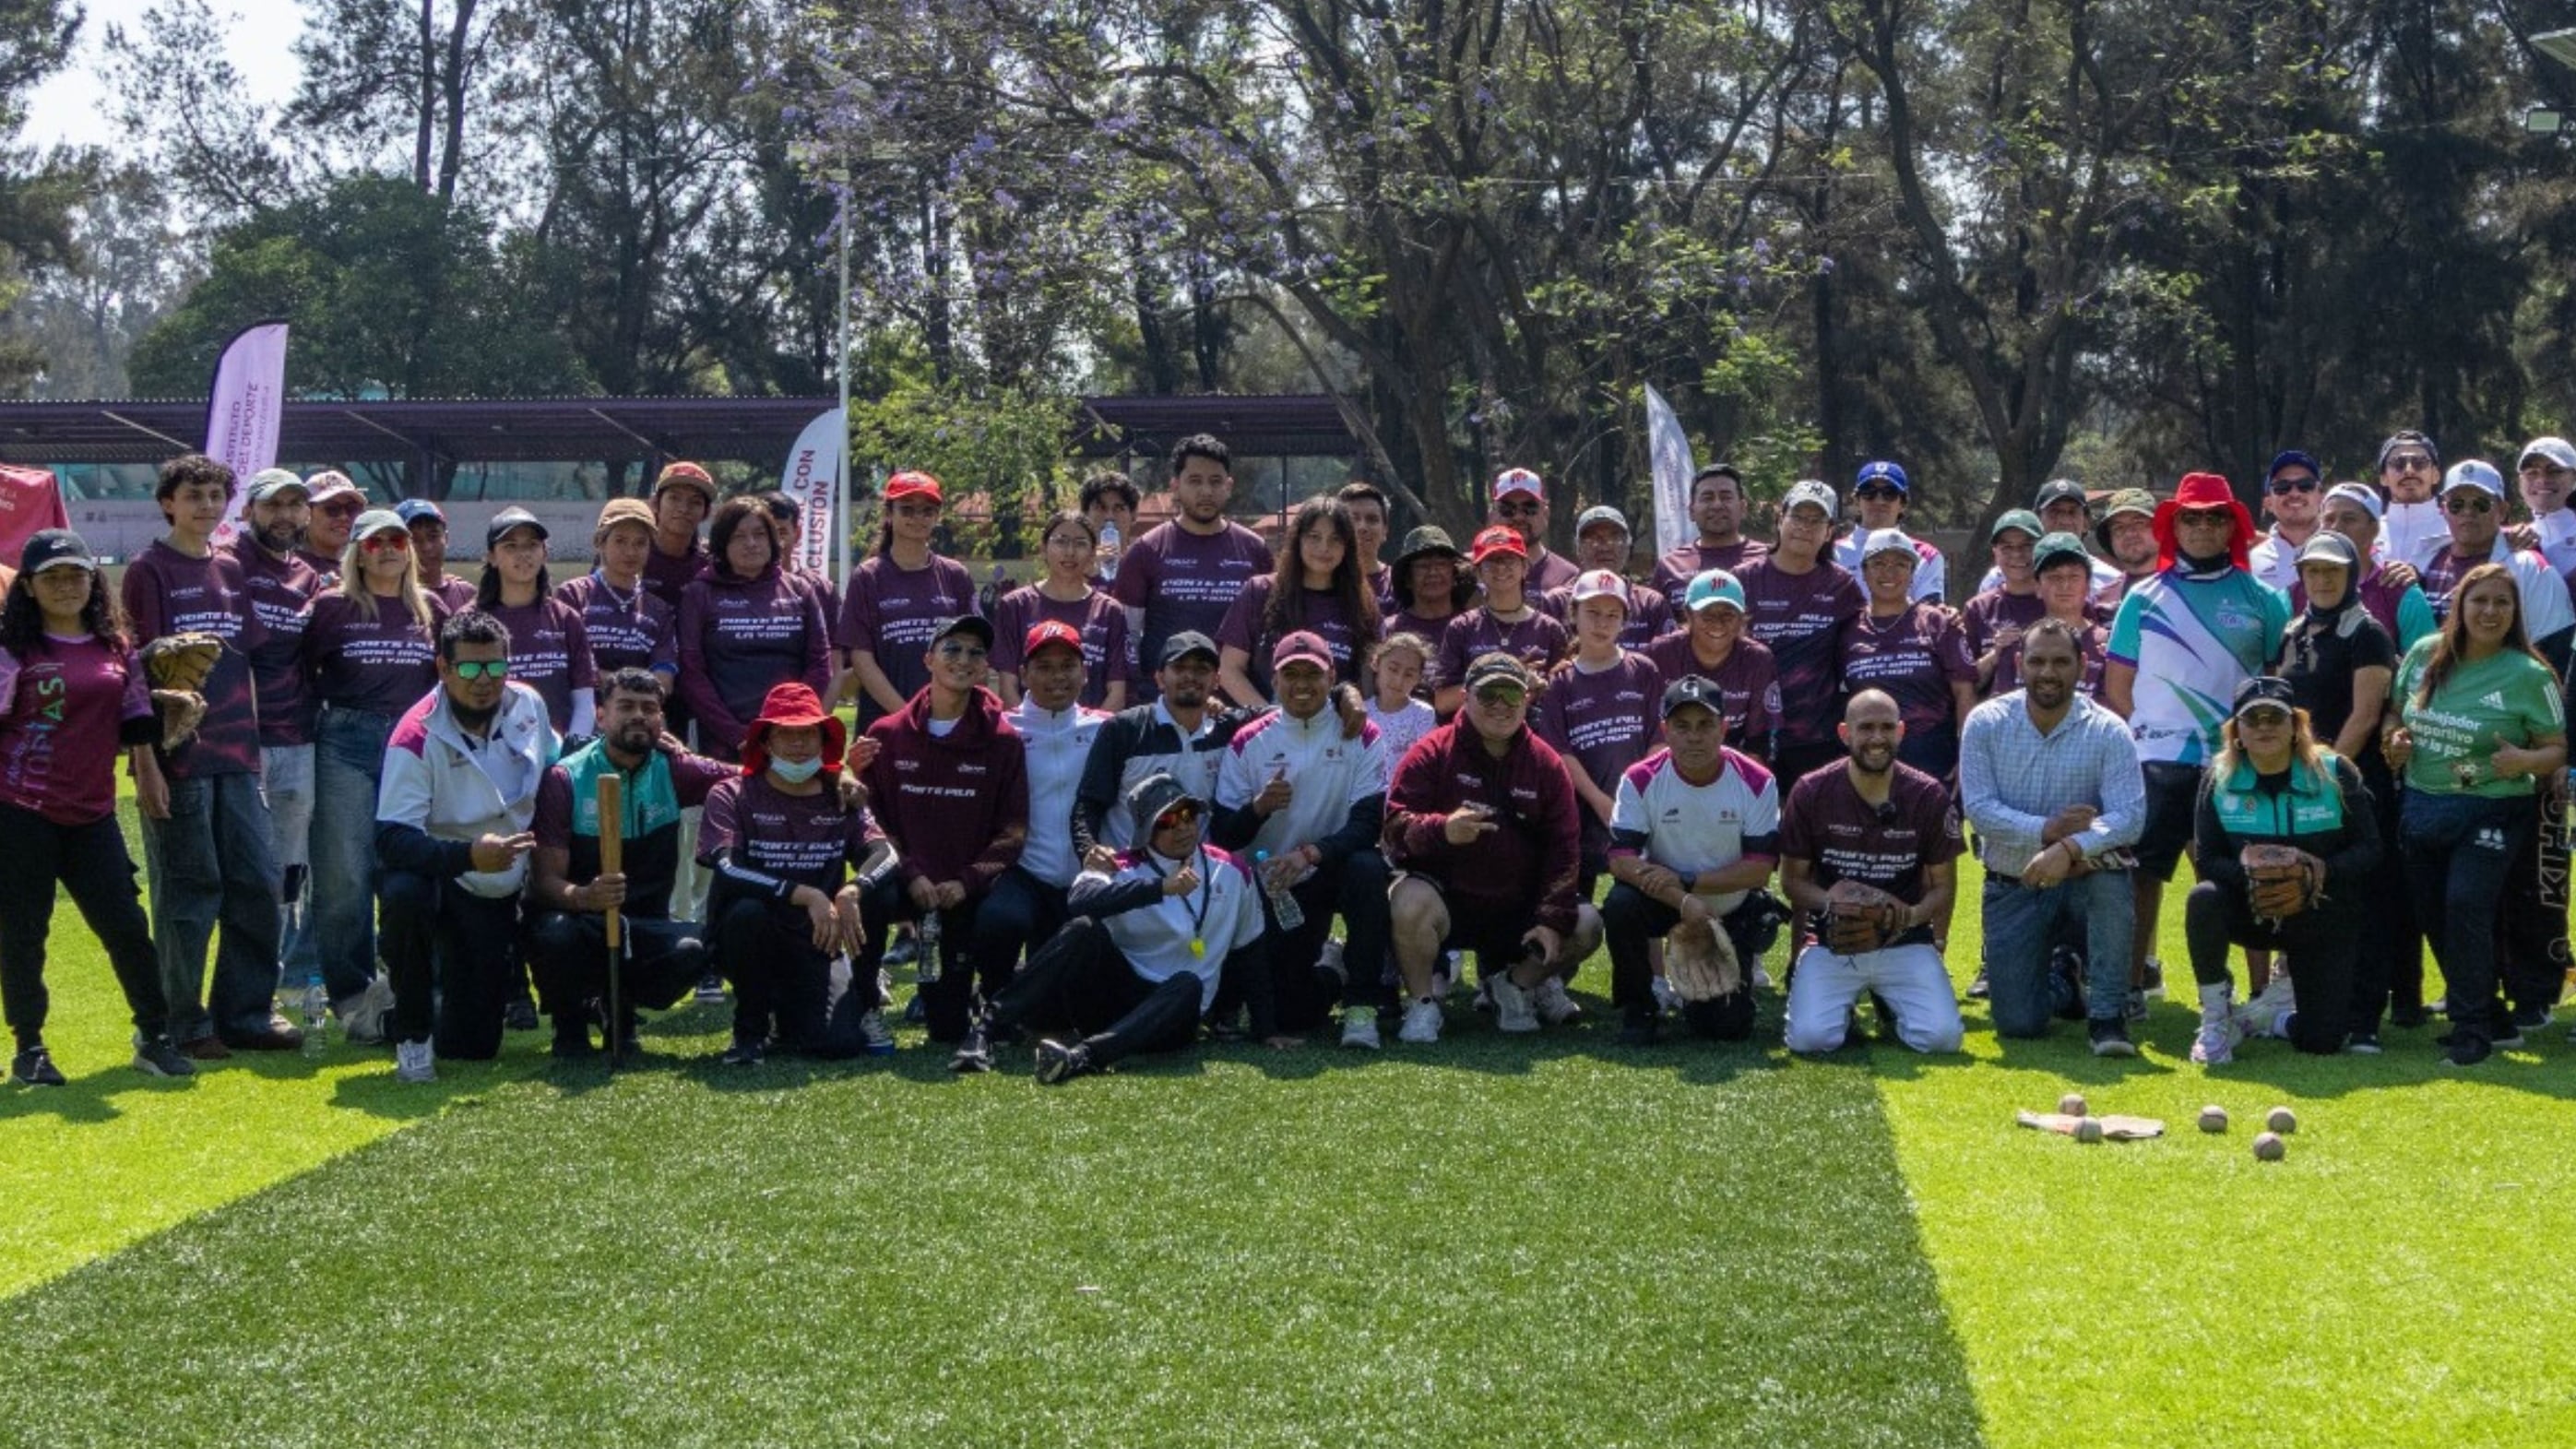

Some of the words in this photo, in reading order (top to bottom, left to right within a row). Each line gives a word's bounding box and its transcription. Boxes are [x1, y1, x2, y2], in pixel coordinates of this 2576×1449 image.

[226, 401, 241, 464] STITUTO
[241, 381, 259, 447] DEPORTE
[237, 448, 250, 476] DEL
[794, 449, 815, 490] CON
[806, 481, 829, 570] CLUSIÓN
[2409, 707, 2483, 731] rabajador
